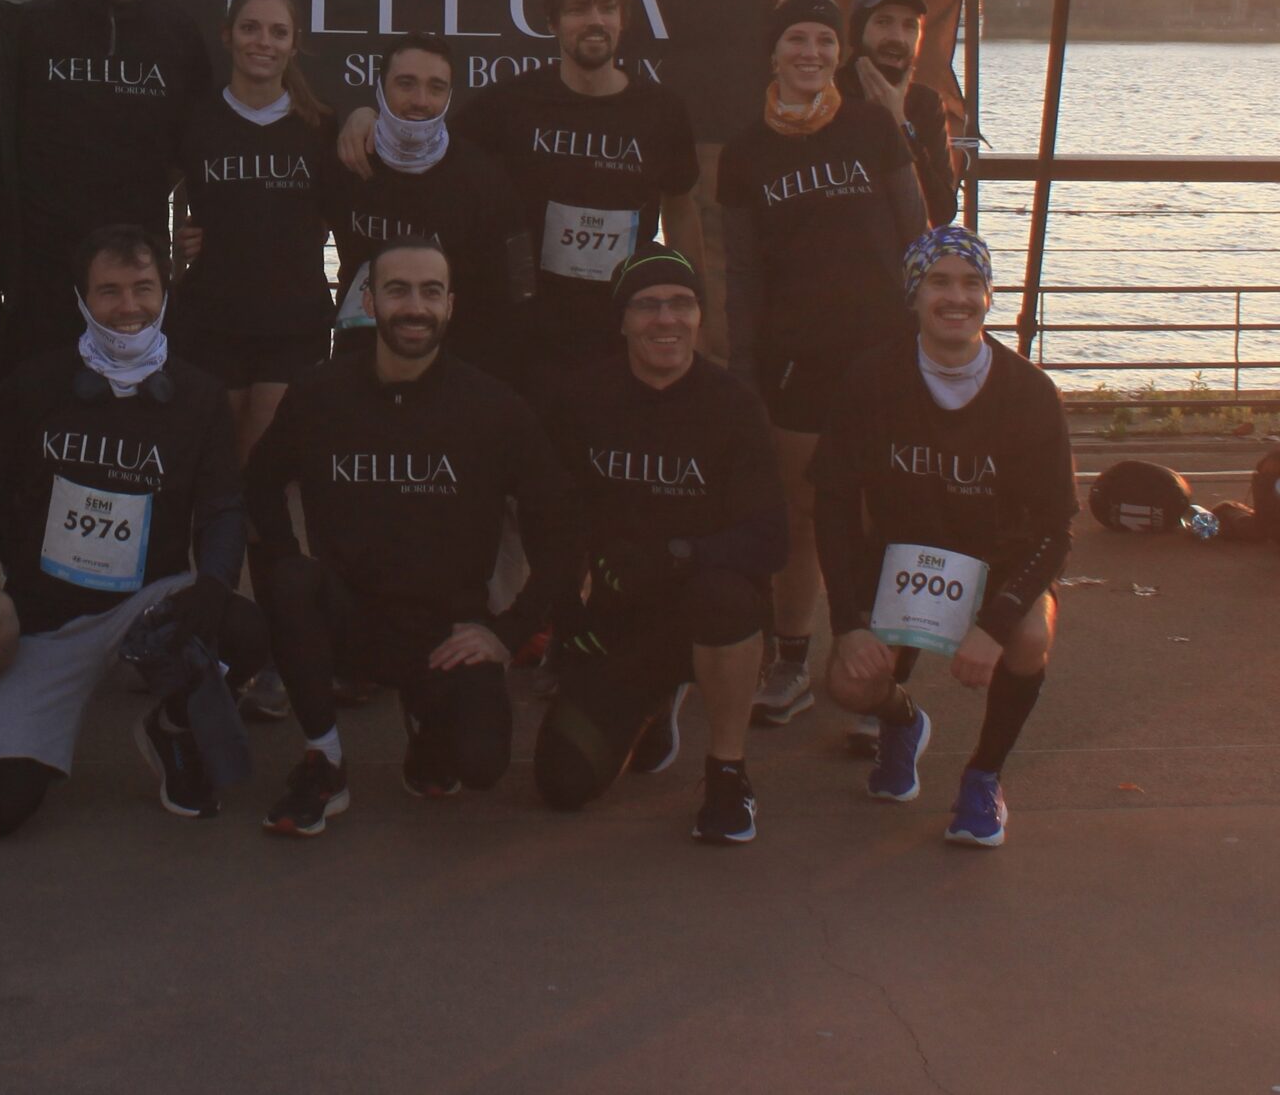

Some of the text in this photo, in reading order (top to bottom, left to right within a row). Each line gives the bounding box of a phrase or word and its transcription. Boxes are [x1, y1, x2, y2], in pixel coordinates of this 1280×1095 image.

[48, 57, 166, 87] KELLUA
[533, 127, 643, 163] KELLUA
[204, 154, 311, 183] KELLUA
[763, 159, 870, 206] KELLUA
[580, 215, 605, 227] SEMI
[561, 228, 620, 251] 5977
[43, 431, 165, 475] KELLUA
[332, 454, 457, 482] KELLUA
[589, 447, 706, 485] KELLUA
[890, 443, 997, 484] KELLUA
[86, 496, 113, 512] SEMI
[64, 509, 131, 542] 5976
[917, 554, 946, 569] SEMI
[896, 571, 964, 602] 9900
